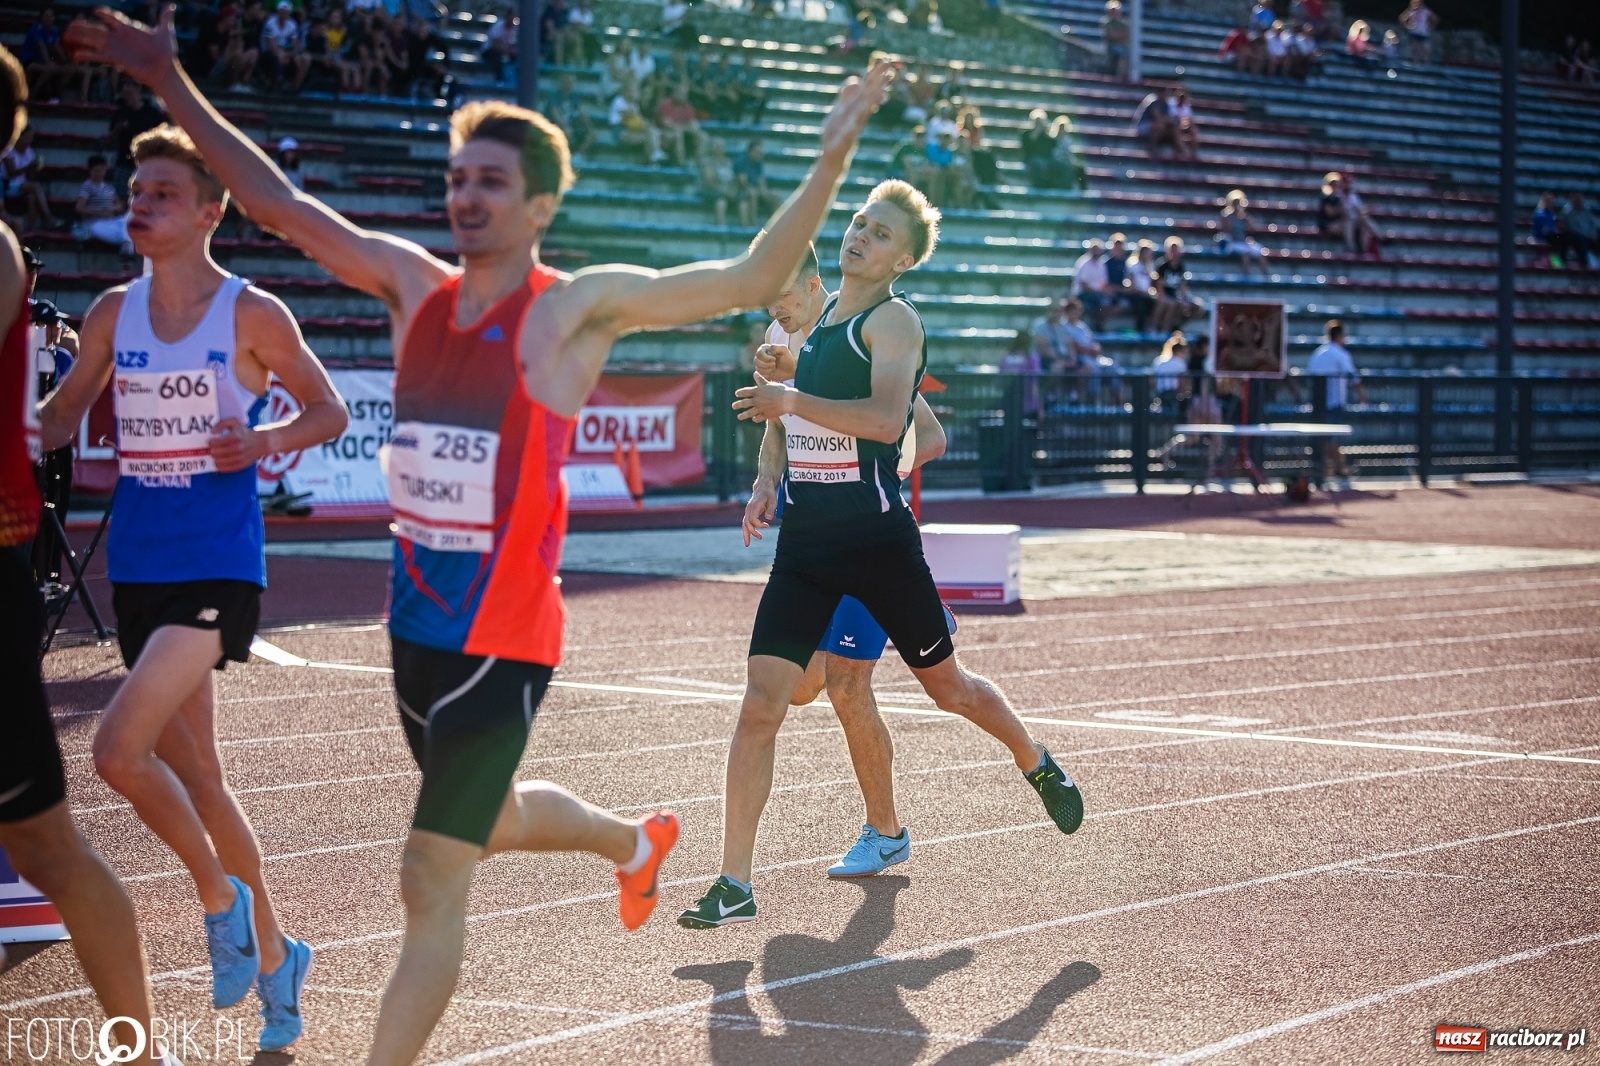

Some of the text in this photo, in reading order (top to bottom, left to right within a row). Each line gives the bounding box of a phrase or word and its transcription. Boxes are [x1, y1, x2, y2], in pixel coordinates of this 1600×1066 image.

[159, 375, 209, 400] 606
[121, 414, 215, 437] PRZYBYLAK
[583, 414, 669, 443] ORLEN
[432, 431, 488, 464] 285
[787, 434, 853, 452] OSTROWSKI
[179, 459, 207, 472] 2019
[789, 469, 847, 481] ACIBÓRZ 2019
